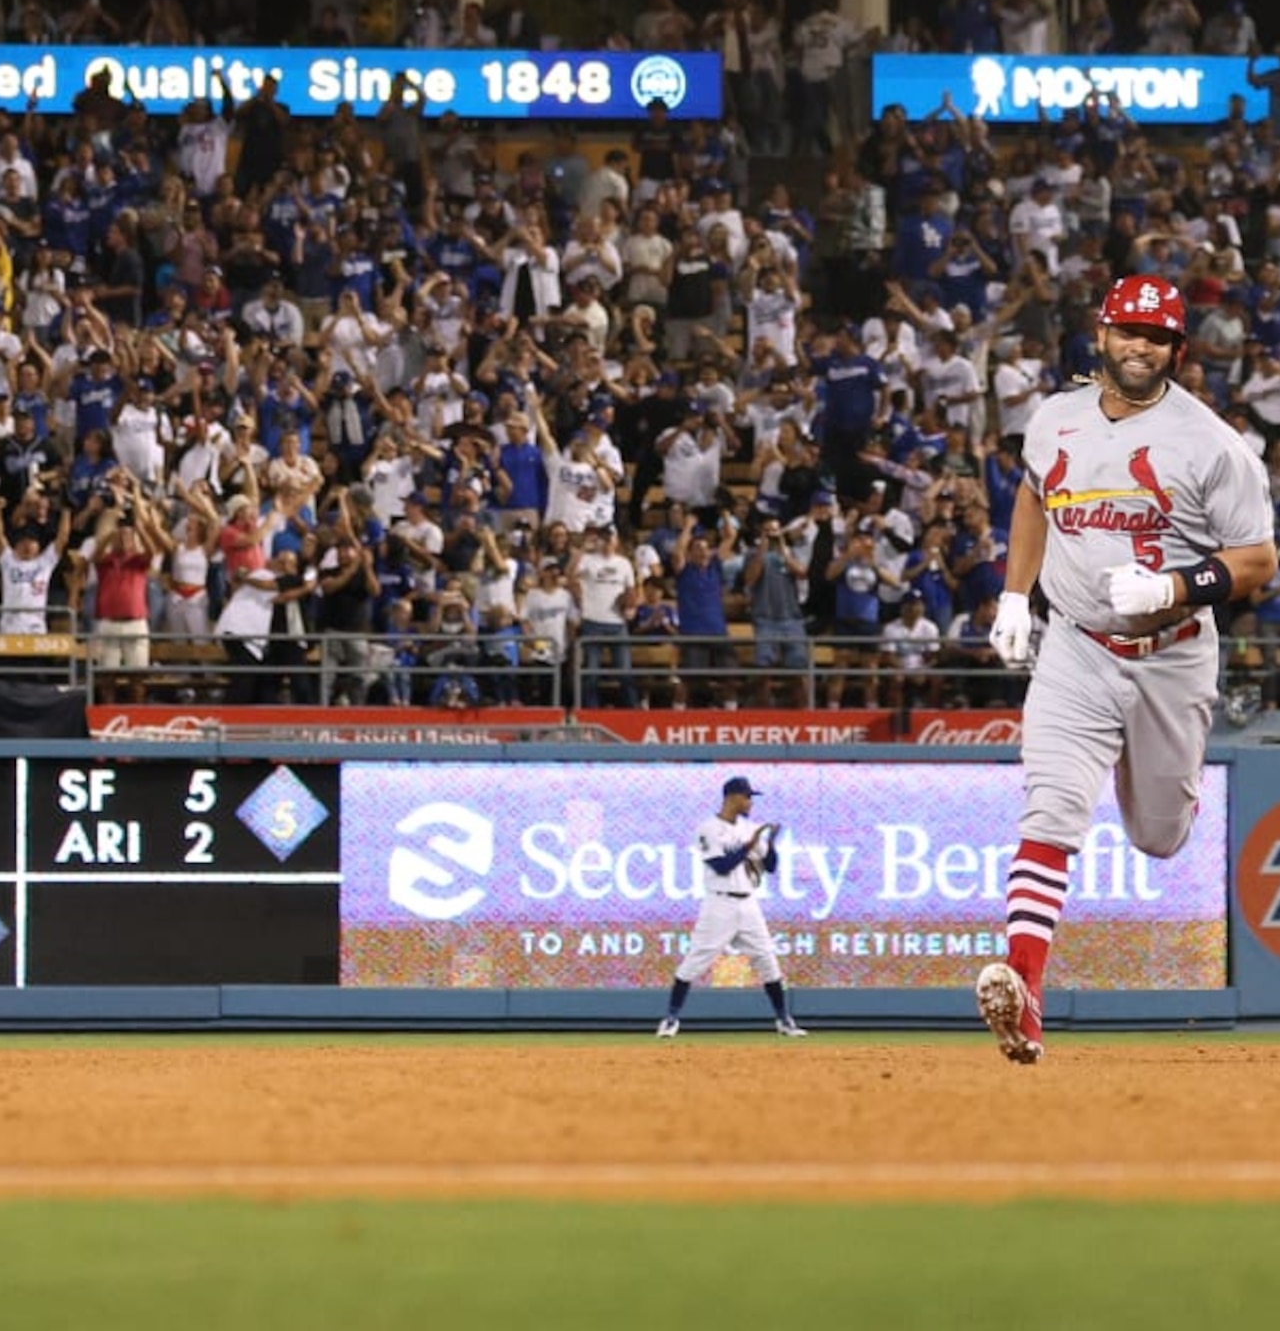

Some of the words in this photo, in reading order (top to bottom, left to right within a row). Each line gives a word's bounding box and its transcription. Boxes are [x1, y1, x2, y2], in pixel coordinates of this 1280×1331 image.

[482, 60, 612, 104] 1848
[1054, 501, 1173, 537] Cardinals
[1131, 533, 1165, 573] 5
[641, 725, 662, 744] A
[667, 725, 710, 744] HIT
[716, 725, 800, 744] EVERY
[806, 725, 869, 744] TIME
[59, 769, 116, 812] SF
[184, 770, 216, 812] 5
[55, 821, 140, 863] ARI
[184, 821, 214, 863] 2
[520, 821, 855, 919] Secuty
[876, 819, 1162, 901] Benfit
[521, 933, 562, 955] TO
[577, 933, 644, 955] AND
[660, 933, 815, 955] THGH
